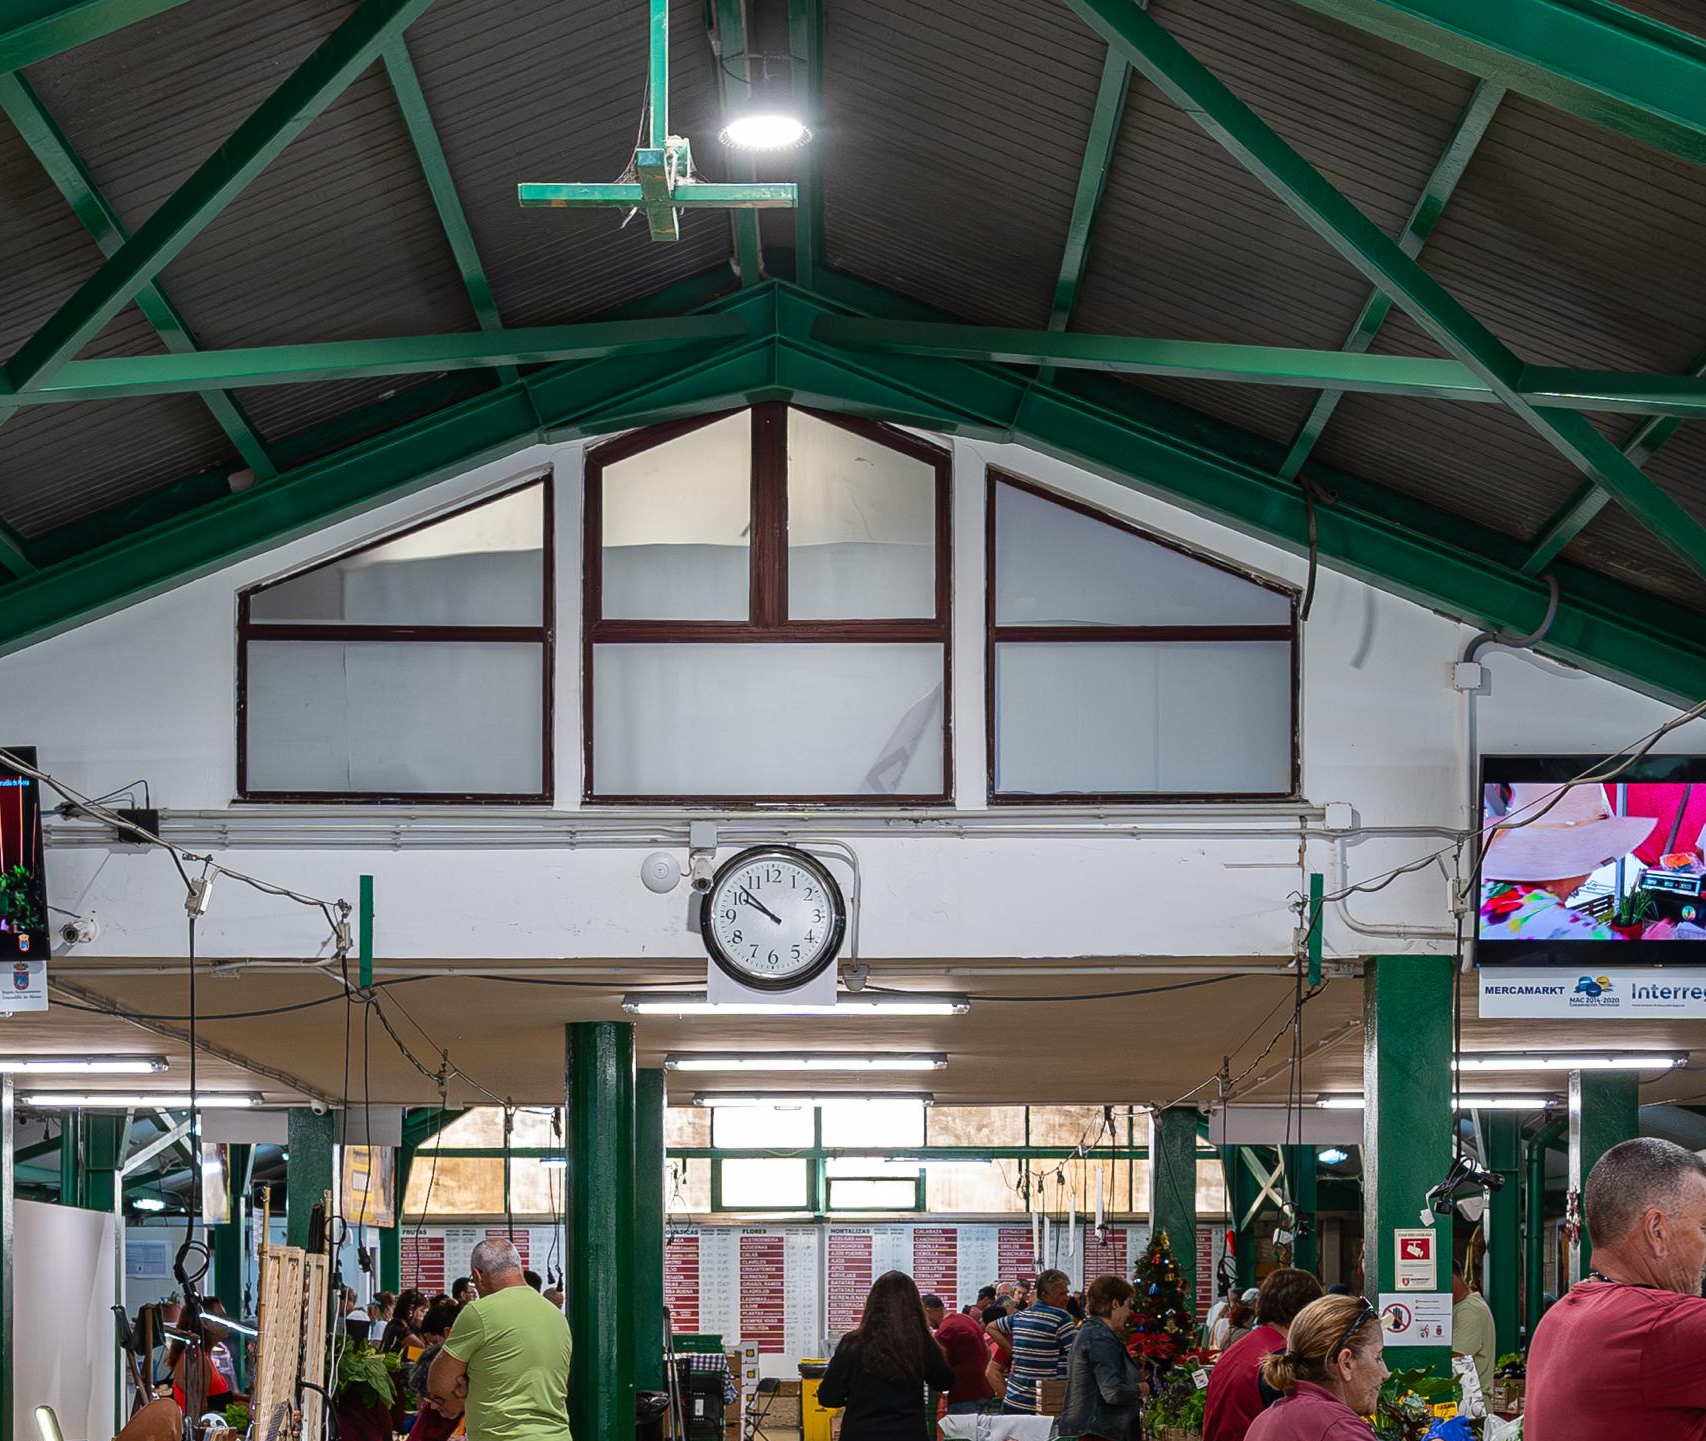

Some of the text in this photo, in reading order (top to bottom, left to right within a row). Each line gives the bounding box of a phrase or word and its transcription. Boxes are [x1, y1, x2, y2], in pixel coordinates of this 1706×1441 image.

[748, 876, 761, 889] 11
[765, 869, 782, 883] 12
[791, 875, 797, 888] 1
[733, 892, 749, 906] 10
[803, 887, 813, 902] 2
[726, 909, 736, 924] 9
[812, 909, 822, 923] 3
[732, 930, 743, 944] 8
[804, 930, 815, 943] 4
[749, 945, 759, 958] 7
[768, 950, 779, 964] 6
[791, 945, 801, 959] 5
[1485, 986, 1565, 995] MERCAMARKT
